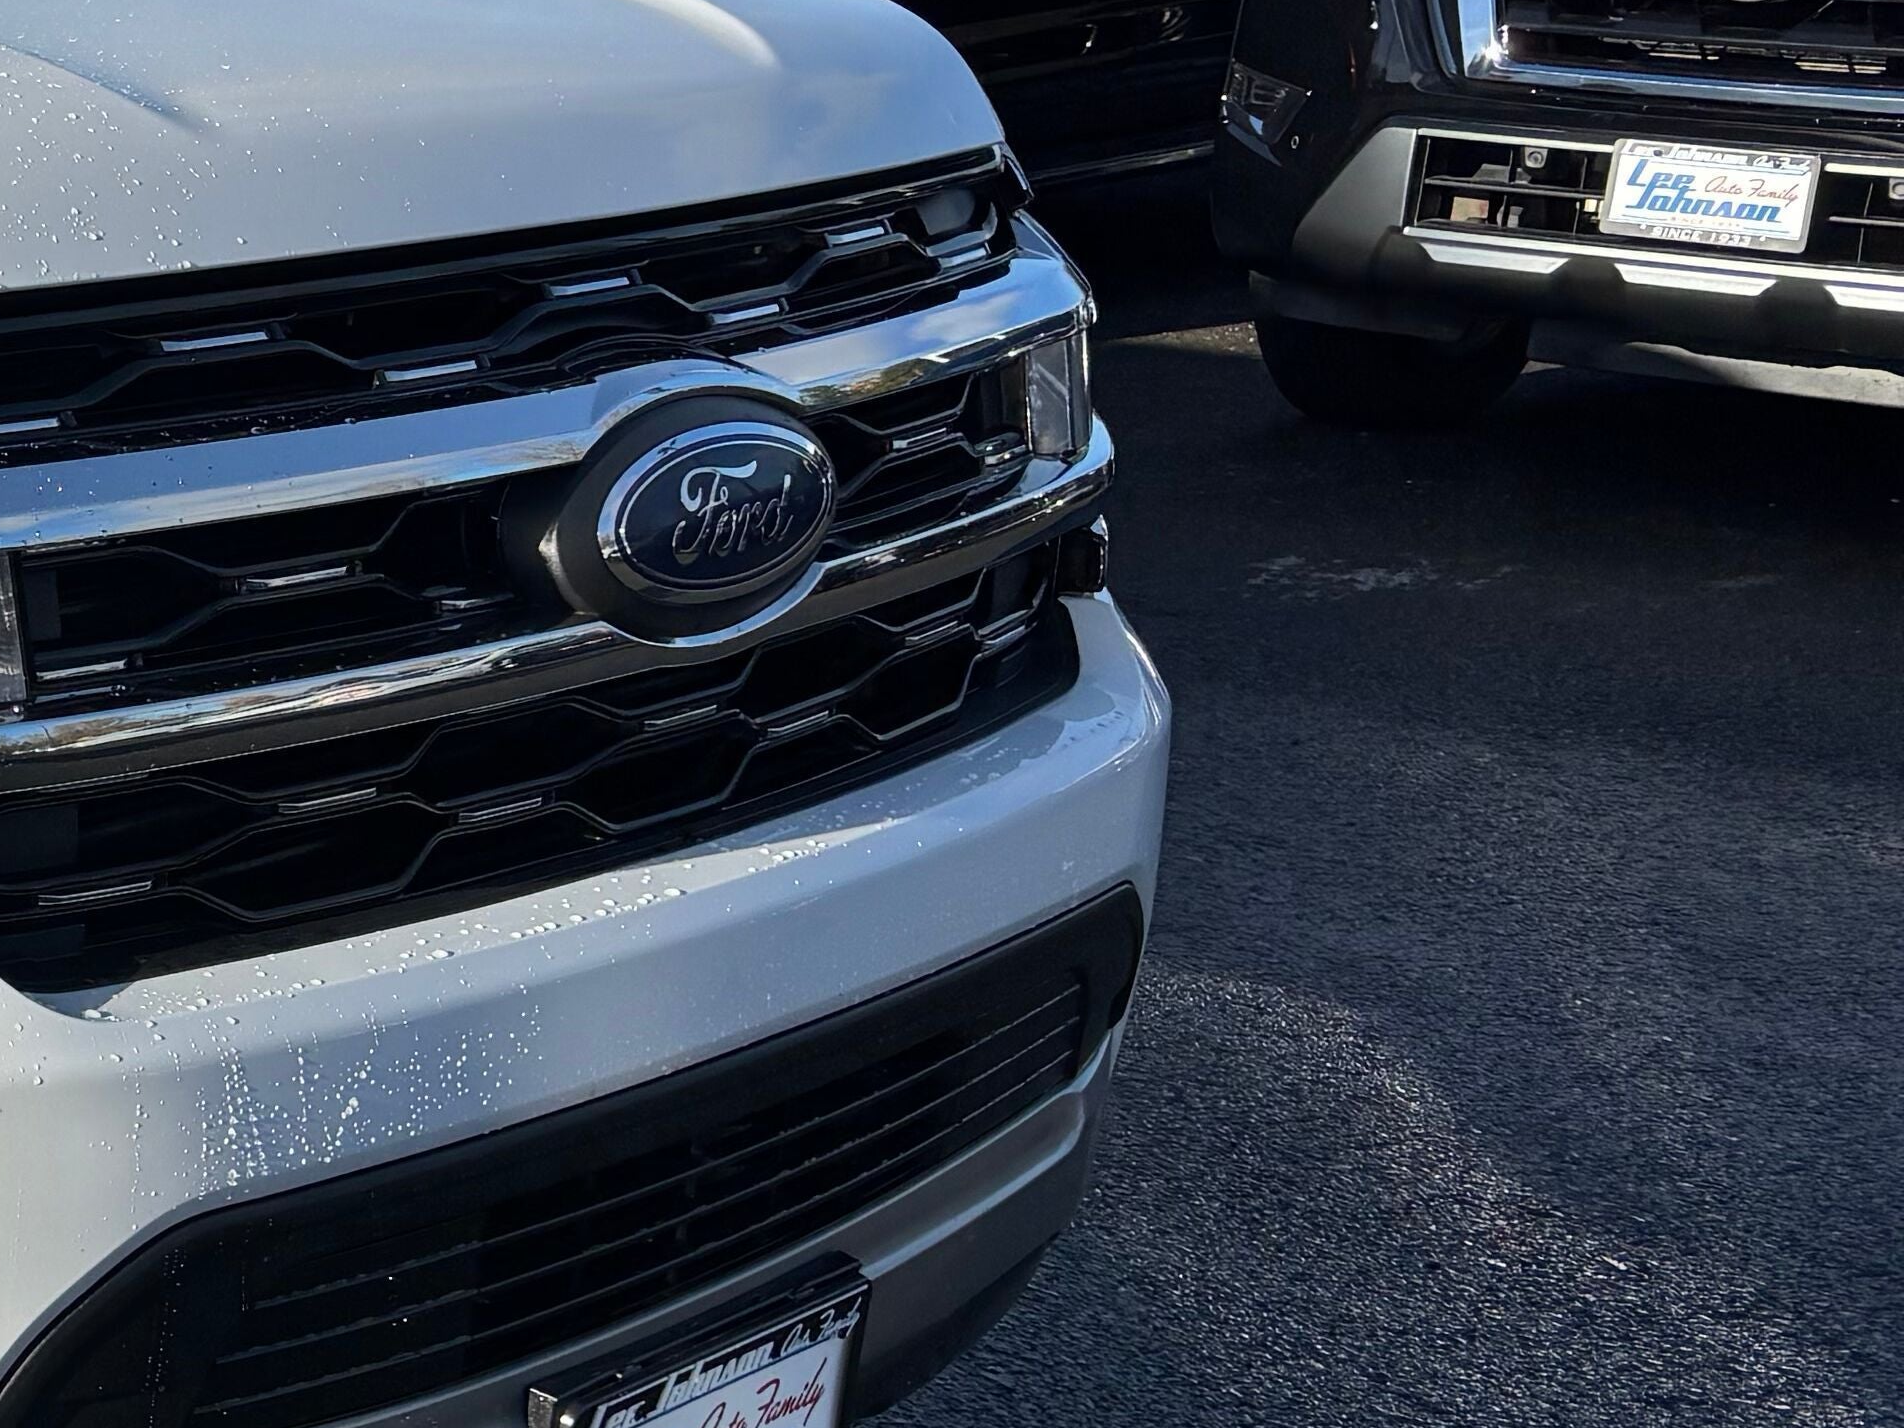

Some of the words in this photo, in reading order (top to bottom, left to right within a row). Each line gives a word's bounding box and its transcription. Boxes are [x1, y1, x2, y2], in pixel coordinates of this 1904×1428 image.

[1625, 178, 1782, 223] Johnson
[1627, 158, 1696, 192] Lee
[1704, 176, 1743, 195] Auto
[1749, 178, 1799, 208] Family
[1651, 227, 1702, 243] SINCE
[1710, 232, 1753, 247] 1933
[672, 460, 794, 565] Ford
